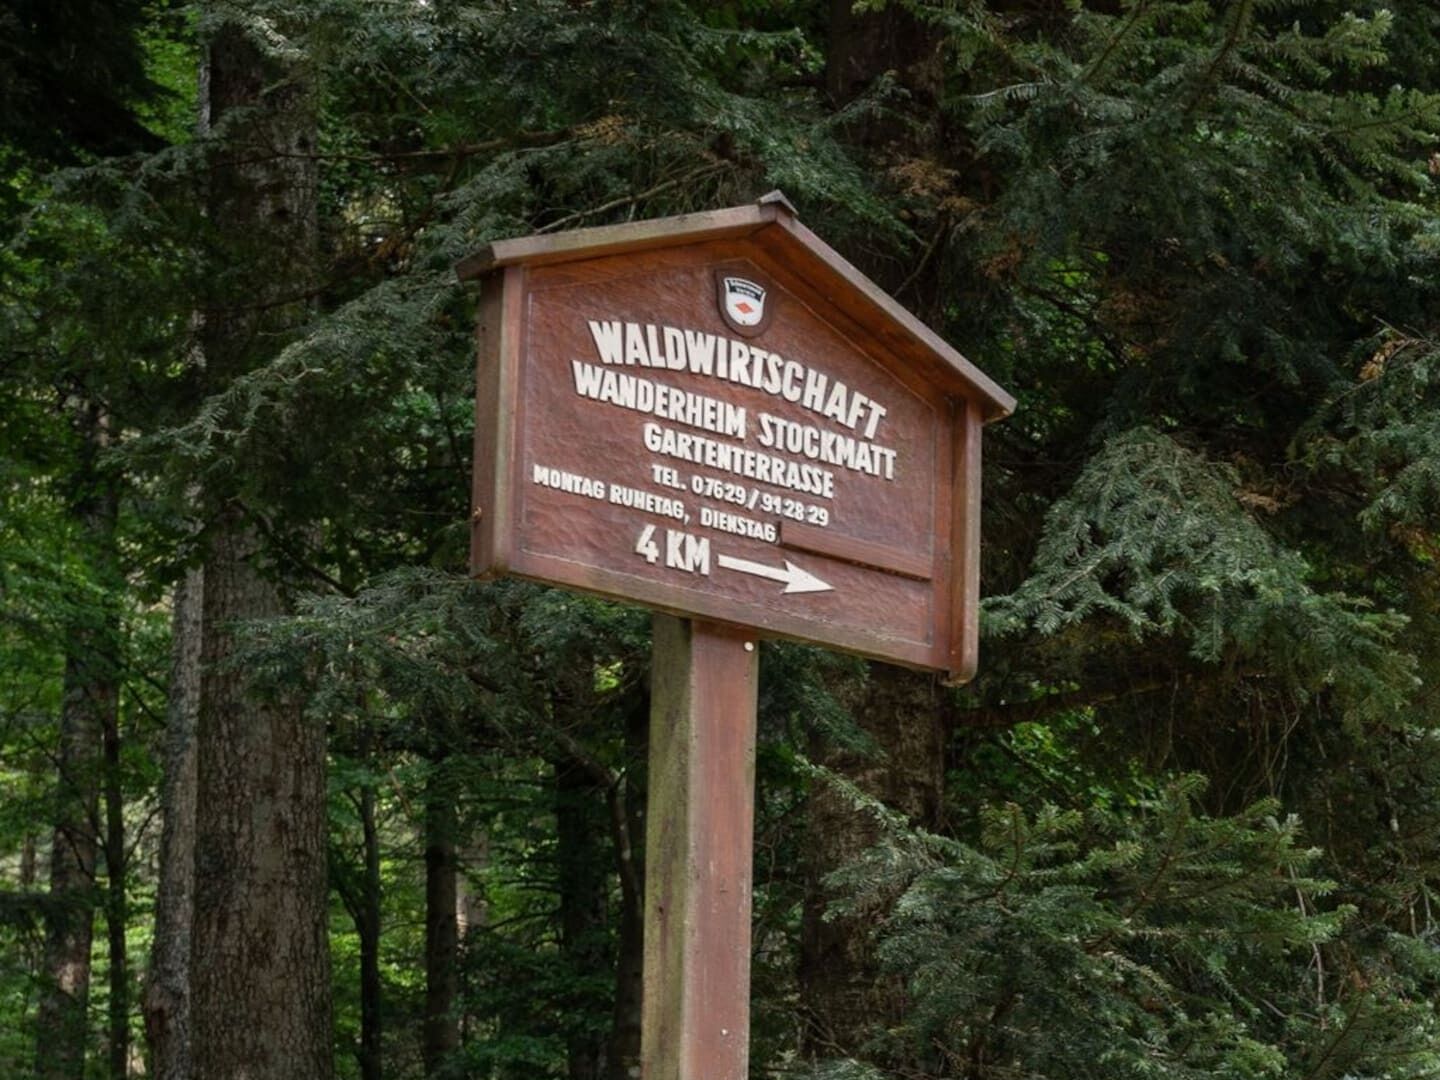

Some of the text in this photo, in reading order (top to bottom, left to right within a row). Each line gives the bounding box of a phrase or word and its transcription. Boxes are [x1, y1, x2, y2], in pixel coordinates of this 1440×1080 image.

[588, 320, 887, 440] WALDWIRTSCHAFT
[572, 359, 897, 481] WANDERHEIM STOCKMATT
[643, 422, 834, 499] GARTENTERRASSE
[652, 464, 688, 491] TEL.
[533, 464, 777, 543] MONTAG RUHETAG, DIENSTAG
[636, 523, 711, 576] 4 KM
